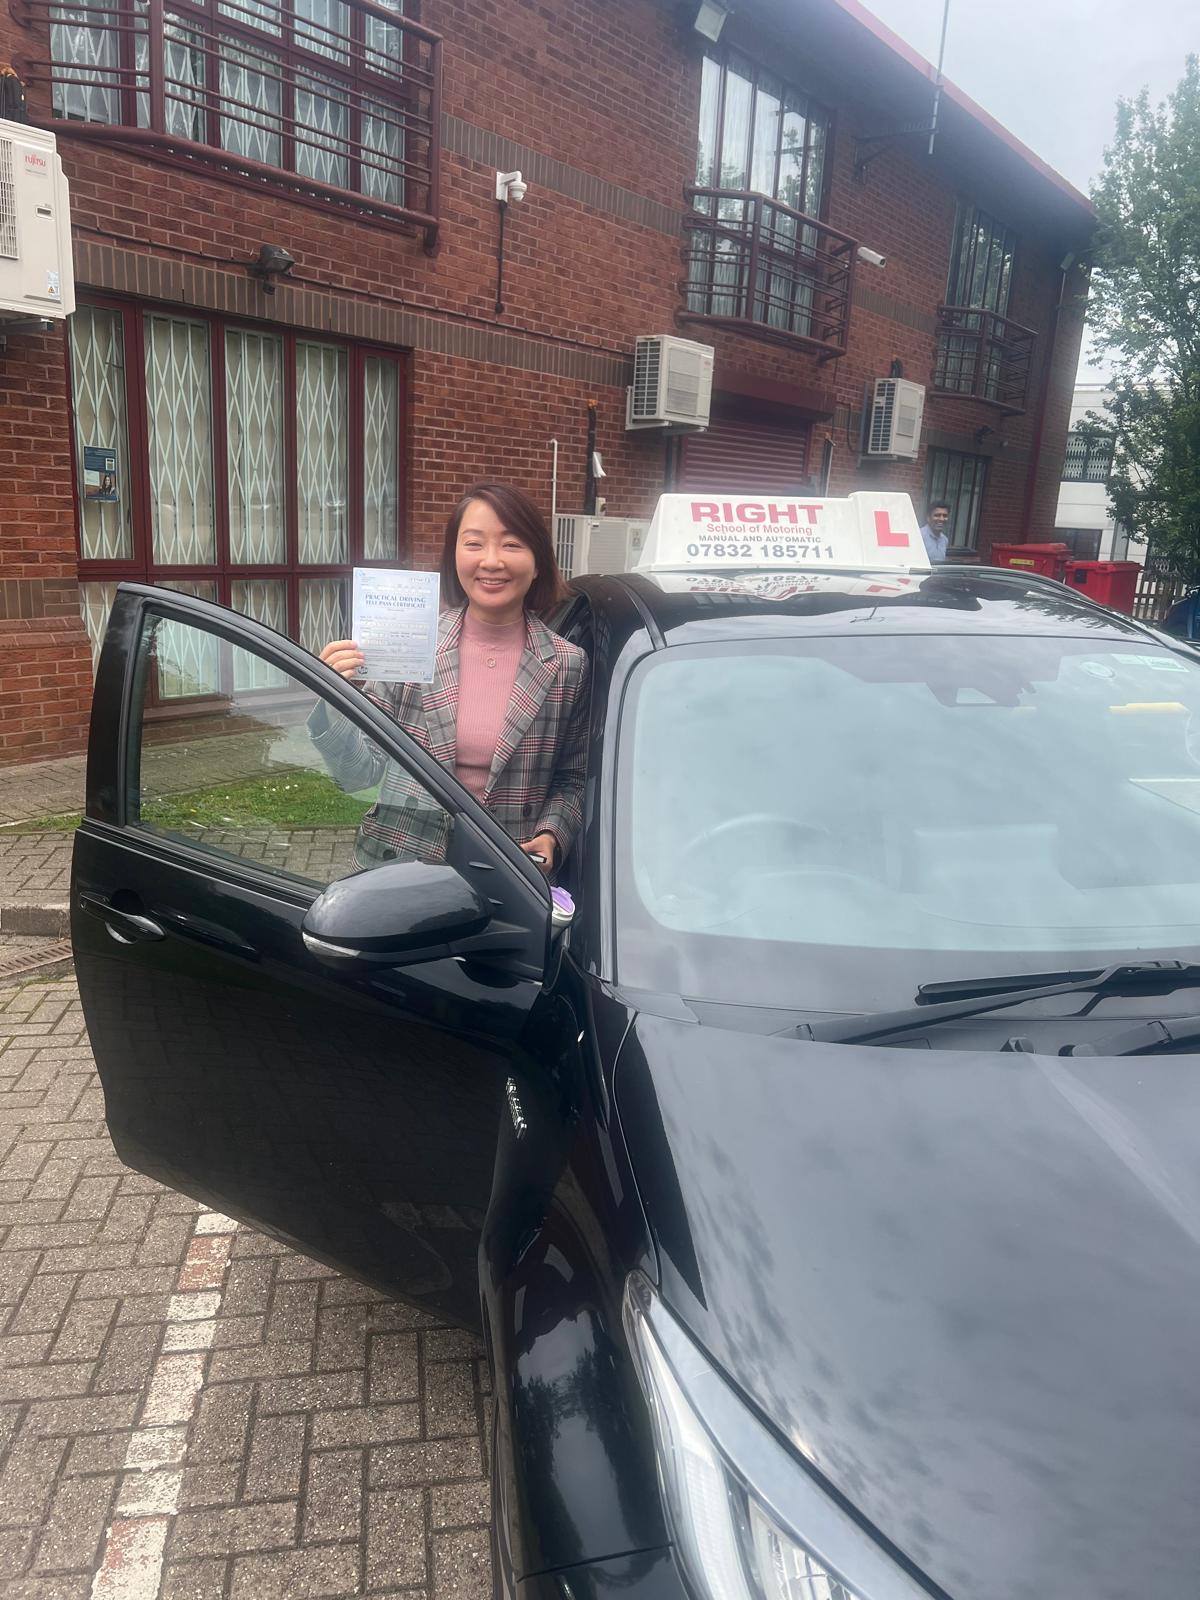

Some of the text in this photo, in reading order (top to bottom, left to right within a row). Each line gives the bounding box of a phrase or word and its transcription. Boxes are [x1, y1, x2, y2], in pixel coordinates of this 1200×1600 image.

[690, 502, 824, 524] RIGHT
[706, 523, 813, 536] School of Motoring
[874, 510, 910, 547] L
[687, 543, 834, 558] 07832 185711
